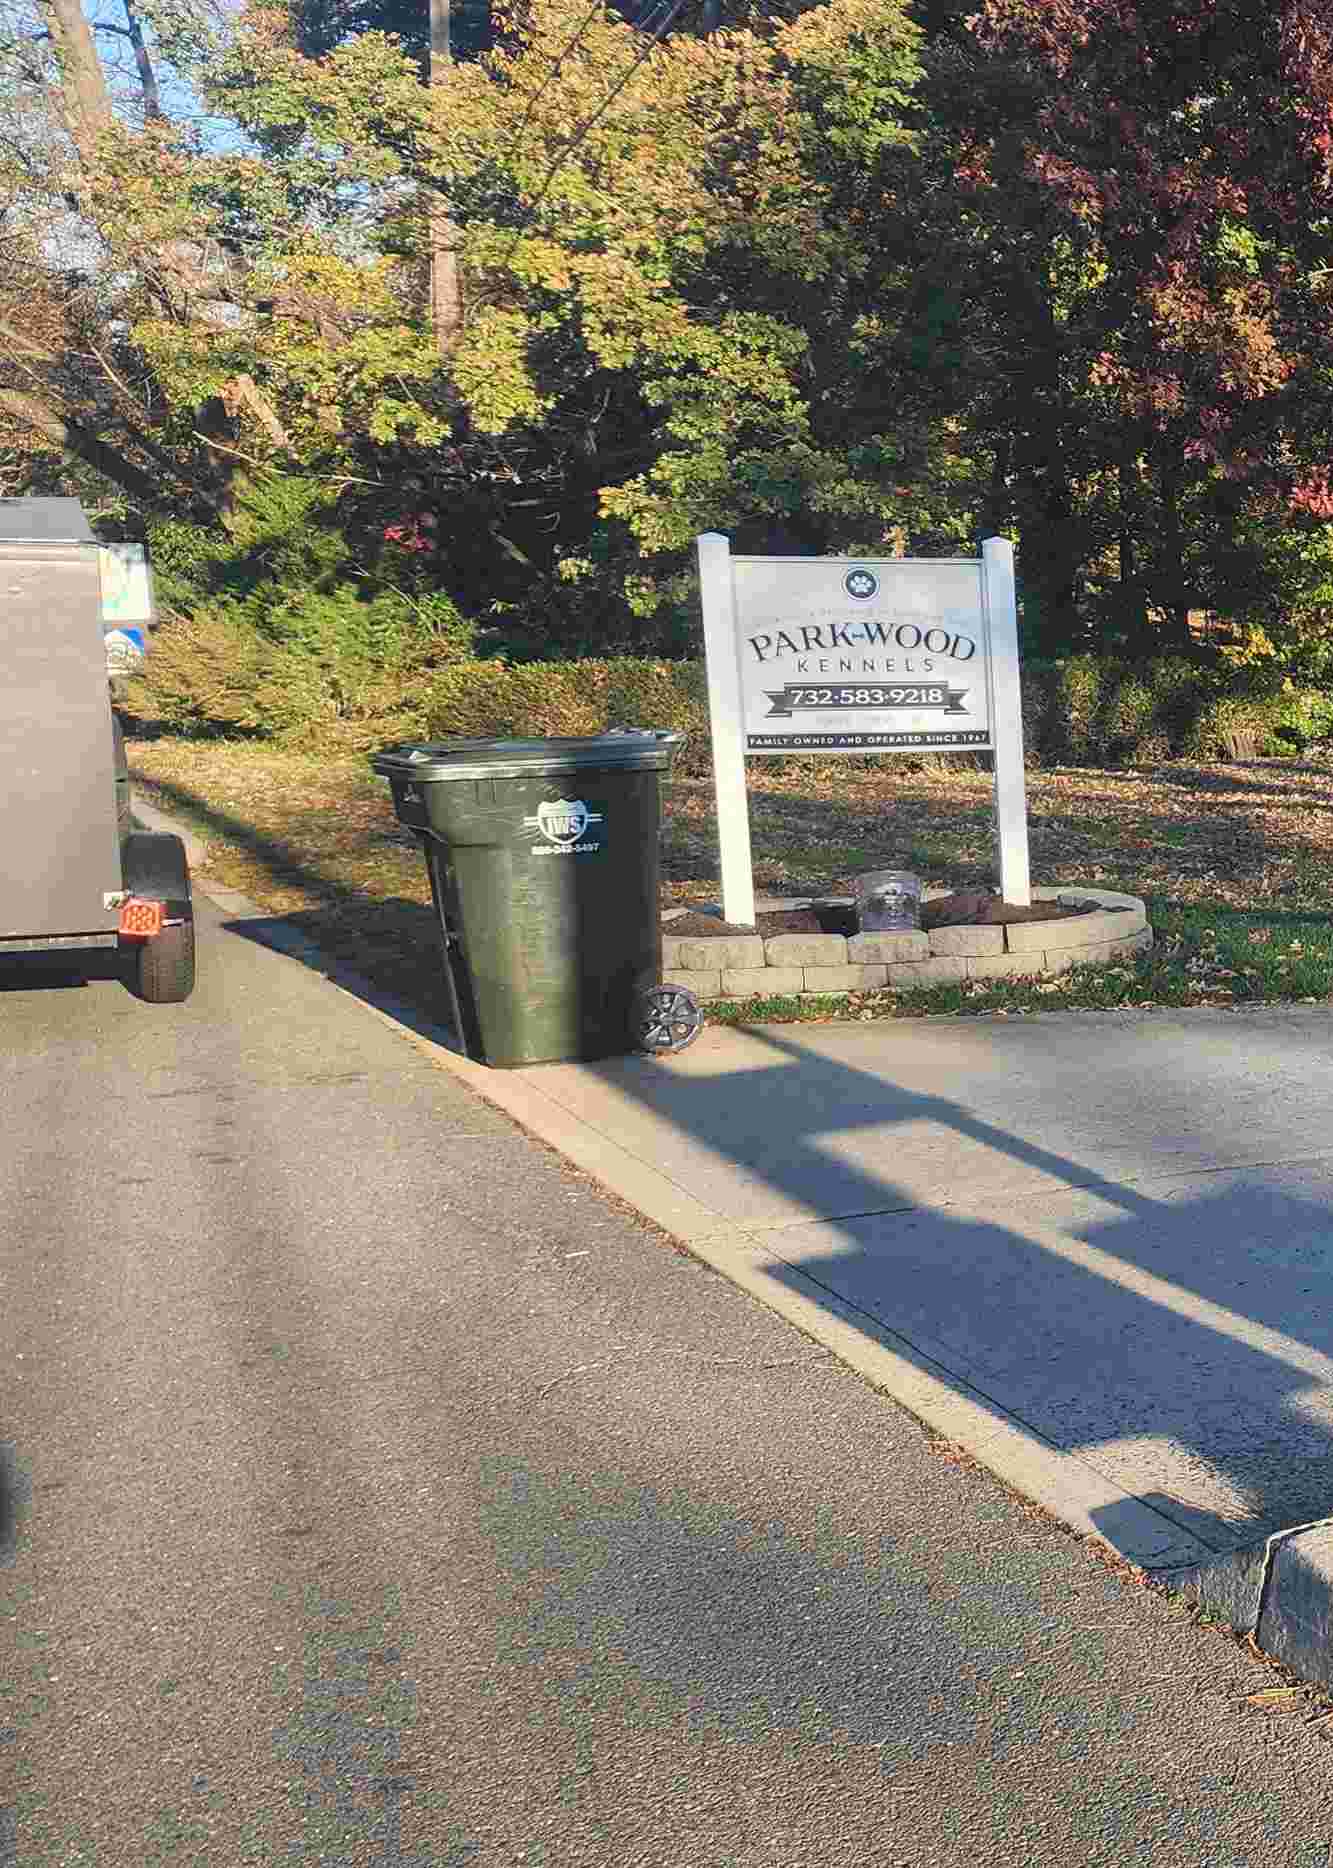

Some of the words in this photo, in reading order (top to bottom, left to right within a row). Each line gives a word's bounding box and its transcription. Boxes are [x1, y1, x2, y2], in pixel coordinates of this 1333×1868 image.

[797, 658, 936, 673] KENNELS
[749, 737, 789, 746] FAMILY
[793, 736, 835, 745] OWNED
[838, 735, 862, 745] AND
[867, 734, 922, 744] OPERATED
[925, 733, 957, 743] SINCE
